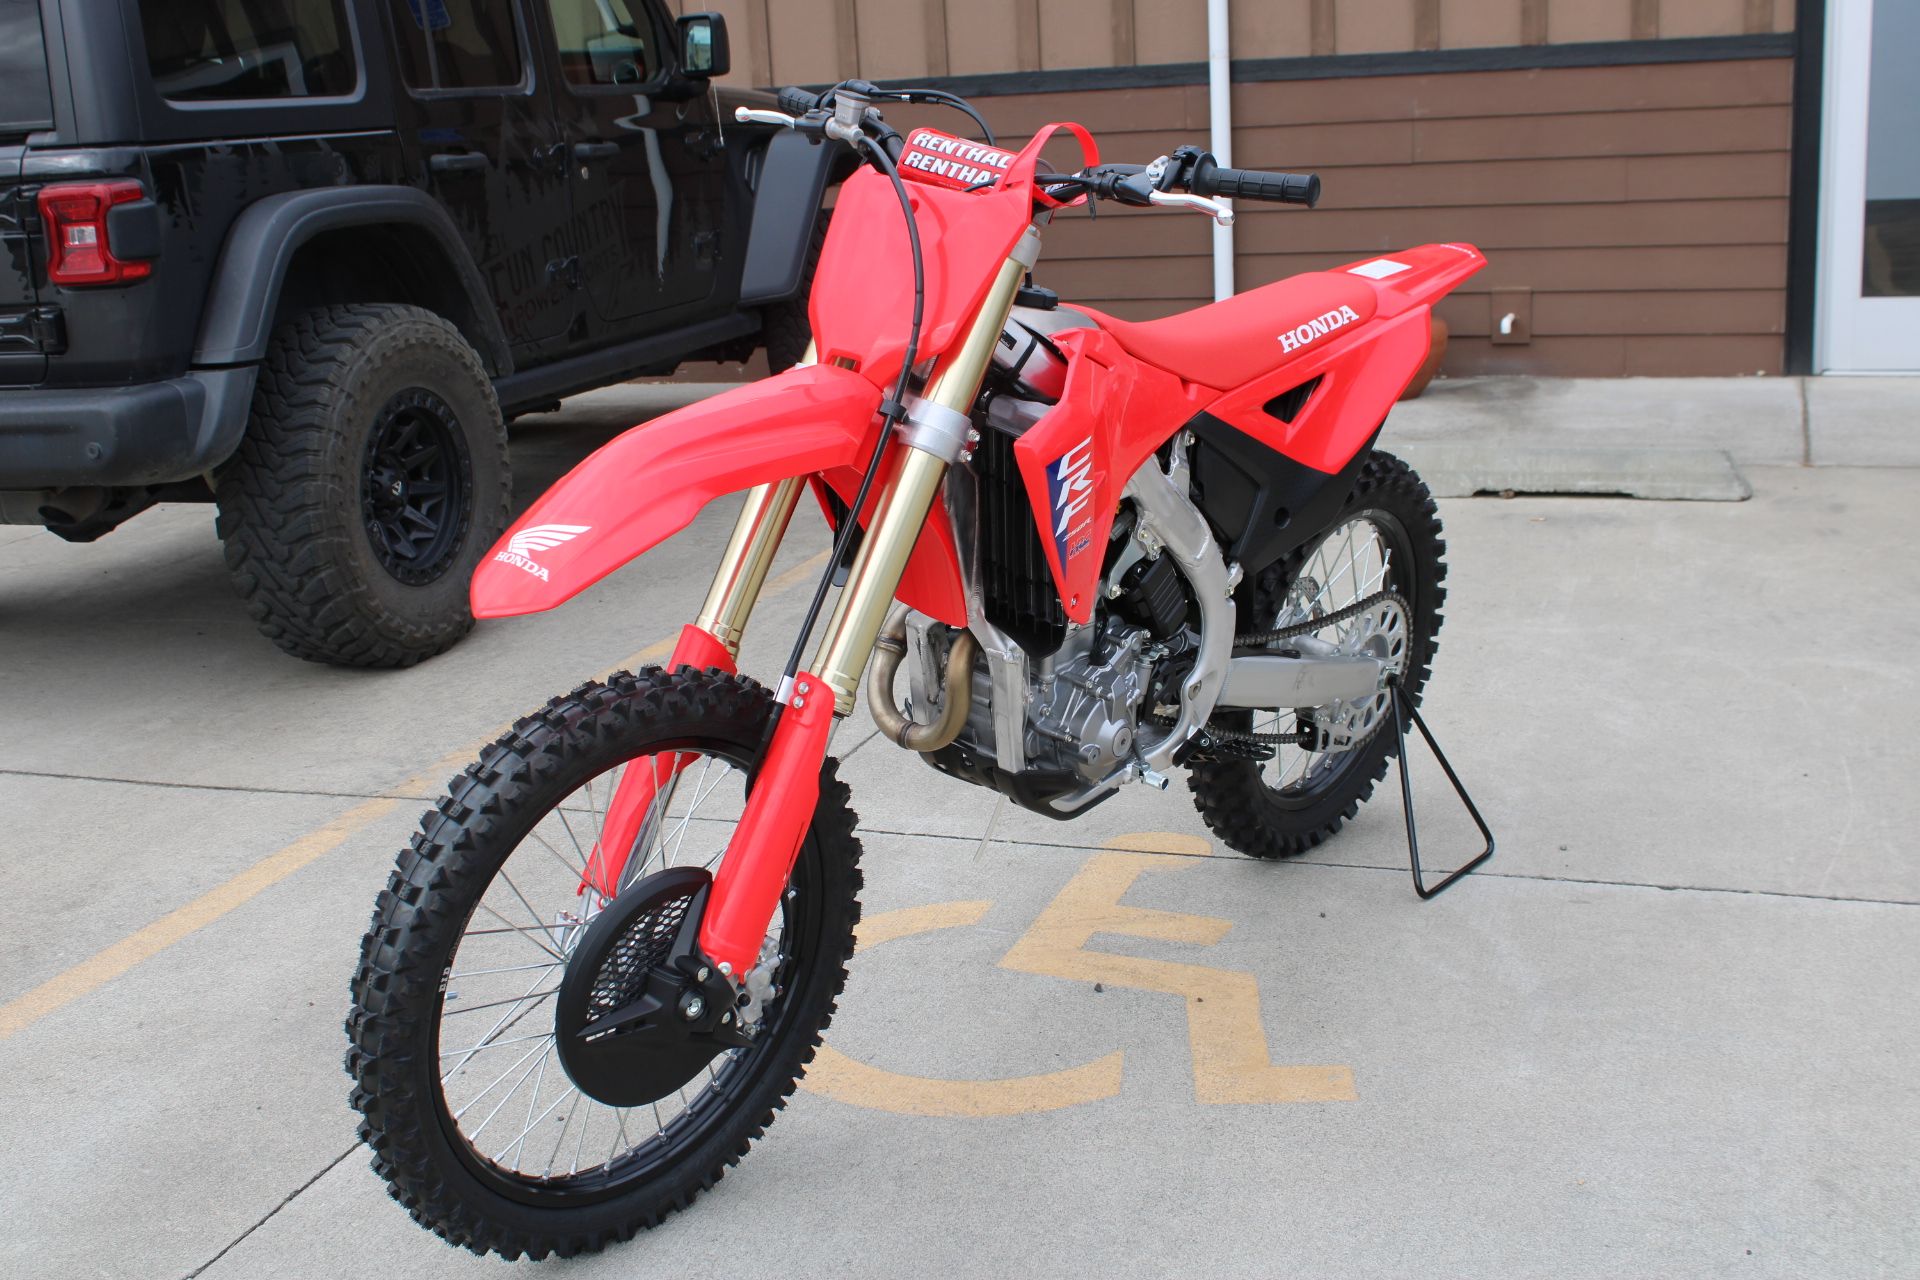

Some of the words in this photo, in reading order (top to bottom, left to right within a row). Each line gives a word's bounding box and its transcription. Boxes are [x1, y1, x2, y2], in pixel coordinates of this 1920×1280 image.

[905, 151, 1001, 187] RENTHA
[912, 132, 1011, 169] RENTHAL
[1277, 305, 1359, 353] HONDA
[1055, 435, 1092, 537] CRF
[494, 551, 549, 582] HONDA
